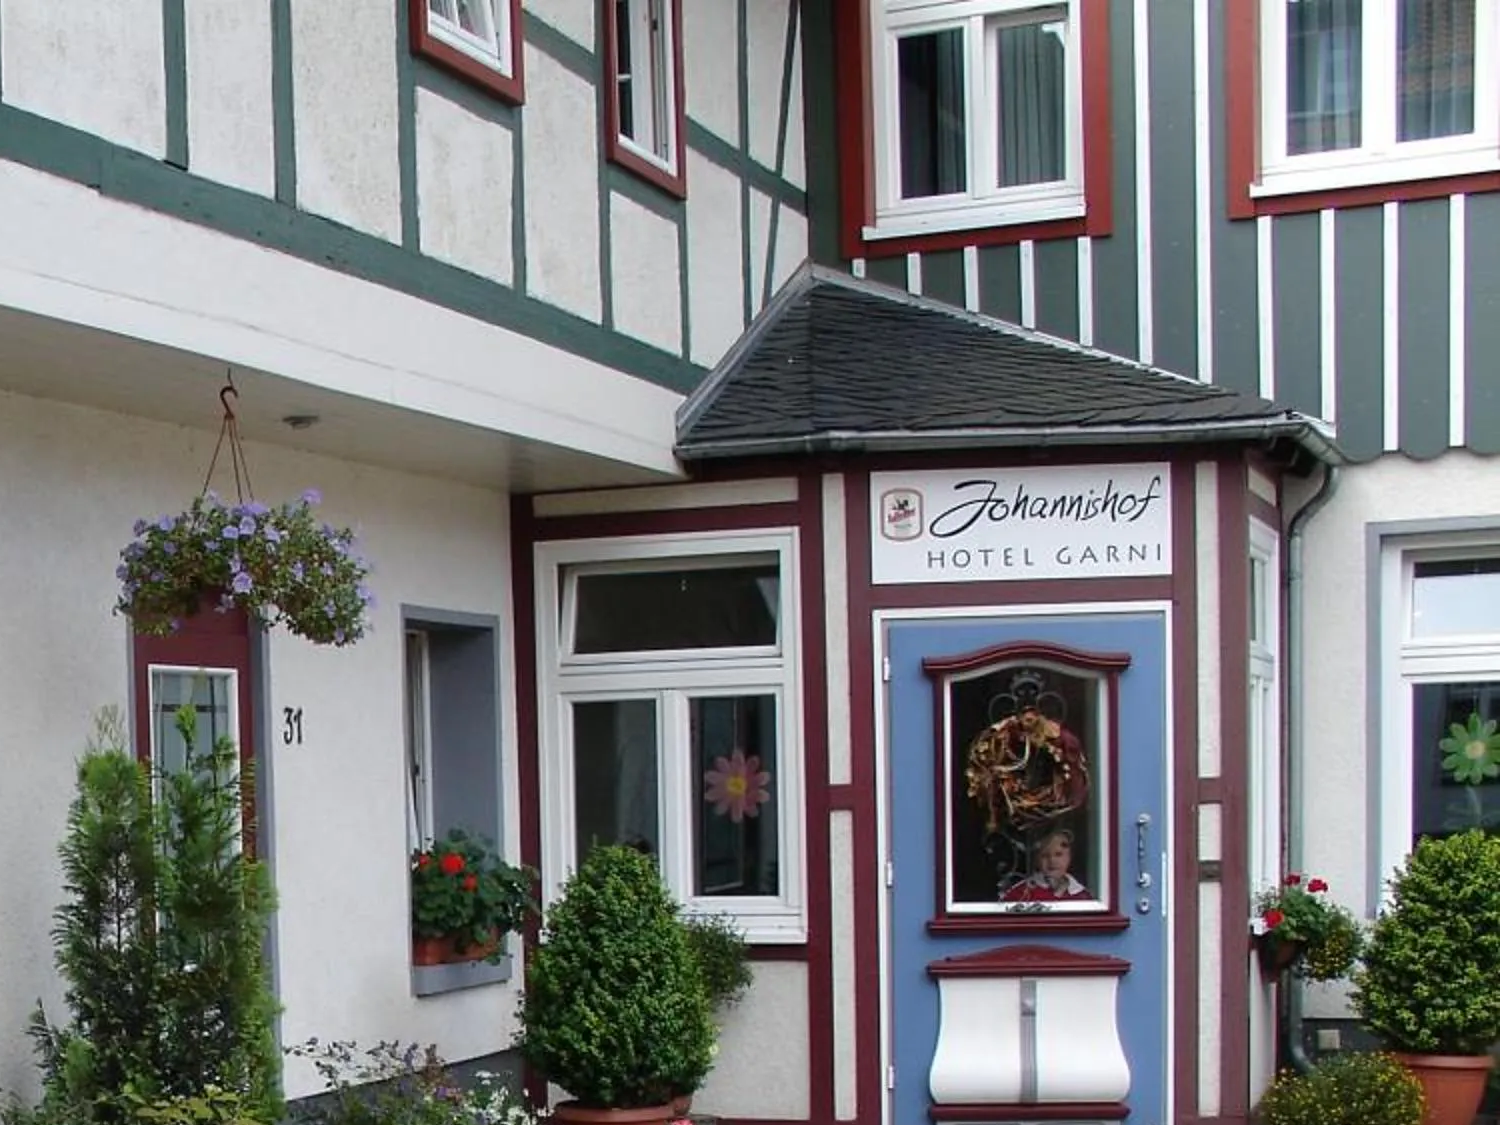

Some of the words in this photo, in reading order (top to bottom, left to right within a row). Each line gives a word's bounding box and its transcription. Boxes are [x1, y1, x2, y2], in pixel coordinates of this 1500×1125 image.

[929, 475, 1161, 538] Johannishof
[928, 548, 1034, 569] HOTEL
[1056, 543, 1162, 565] GARNI
[284, 706, 303, 745] 31
